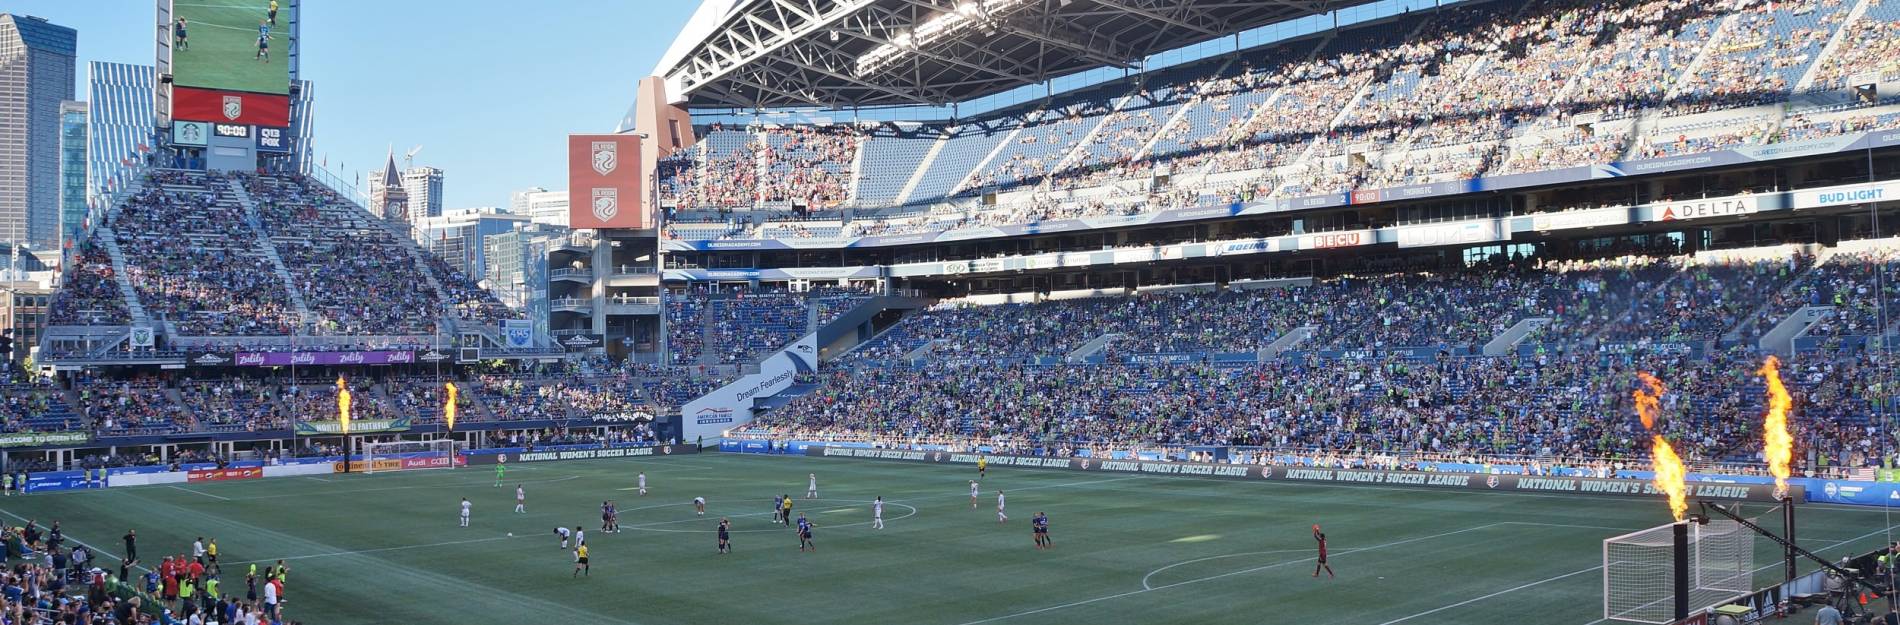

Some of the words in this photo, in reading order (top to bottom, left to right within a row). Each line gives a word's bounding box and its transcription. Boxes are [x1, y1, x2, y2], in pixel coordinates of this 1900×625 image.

[216, 125, 247, 137] 90:00
[261, 128, 280, 138] Q13
[261, 137, 280, 147] FOX
[1340, 195, 1347, 203] 2
[1355, 192, 1376, 201] 90:00
[1819, 193, 1845, 204] BUD
[1847, 188, 1883, 201] LIGHT
[1683, 201, 1746, 217] DELTA
[1314, 233, 1360, 247] BECU
[1227, 241, 1269, 252] BOEING
[736, 385, 760, 402] Dream
[760, 369, 794, 391] Fearlessly
[316, 423, 341, 432] NORTH
[357, 421, 390, 431] FAITHFUL
[519, 452, 558, 461] NATIONAL
[560, 451, 595, 460] WOMEN'S
[597, 449, 625, 458] SOCCER
[626, 447, 653, 456] LEAGUE
[880, 449, 902, 459] SOCCER
[407, 458, 426, 467] Audi
[1015, 456, 1041, 466] SOCCER
[1042, 458, 1071, 468] LEAGUE
[1100, 460, 1139, 471] NATIONAL
[1141, 462, 1179, 473] WOMEN'S
[1180, 464, 1213, 475] SOCCER
[1214, 465, 1249, 477] LEAGUE
[1285, 469, 1333, 480] NATIONAL
[1336, 470, 1384, 482] WOMEN'S
[1385, 472, 1425, 485] SOCCER
[1427, 474, 1470, 486] LEAGUE
[1516, 477, 1576, 491] NATIONAL
[1580, 480, 1639, 494] WOMEN'S
[1696, 485, 1750, 498] LEAGUE
